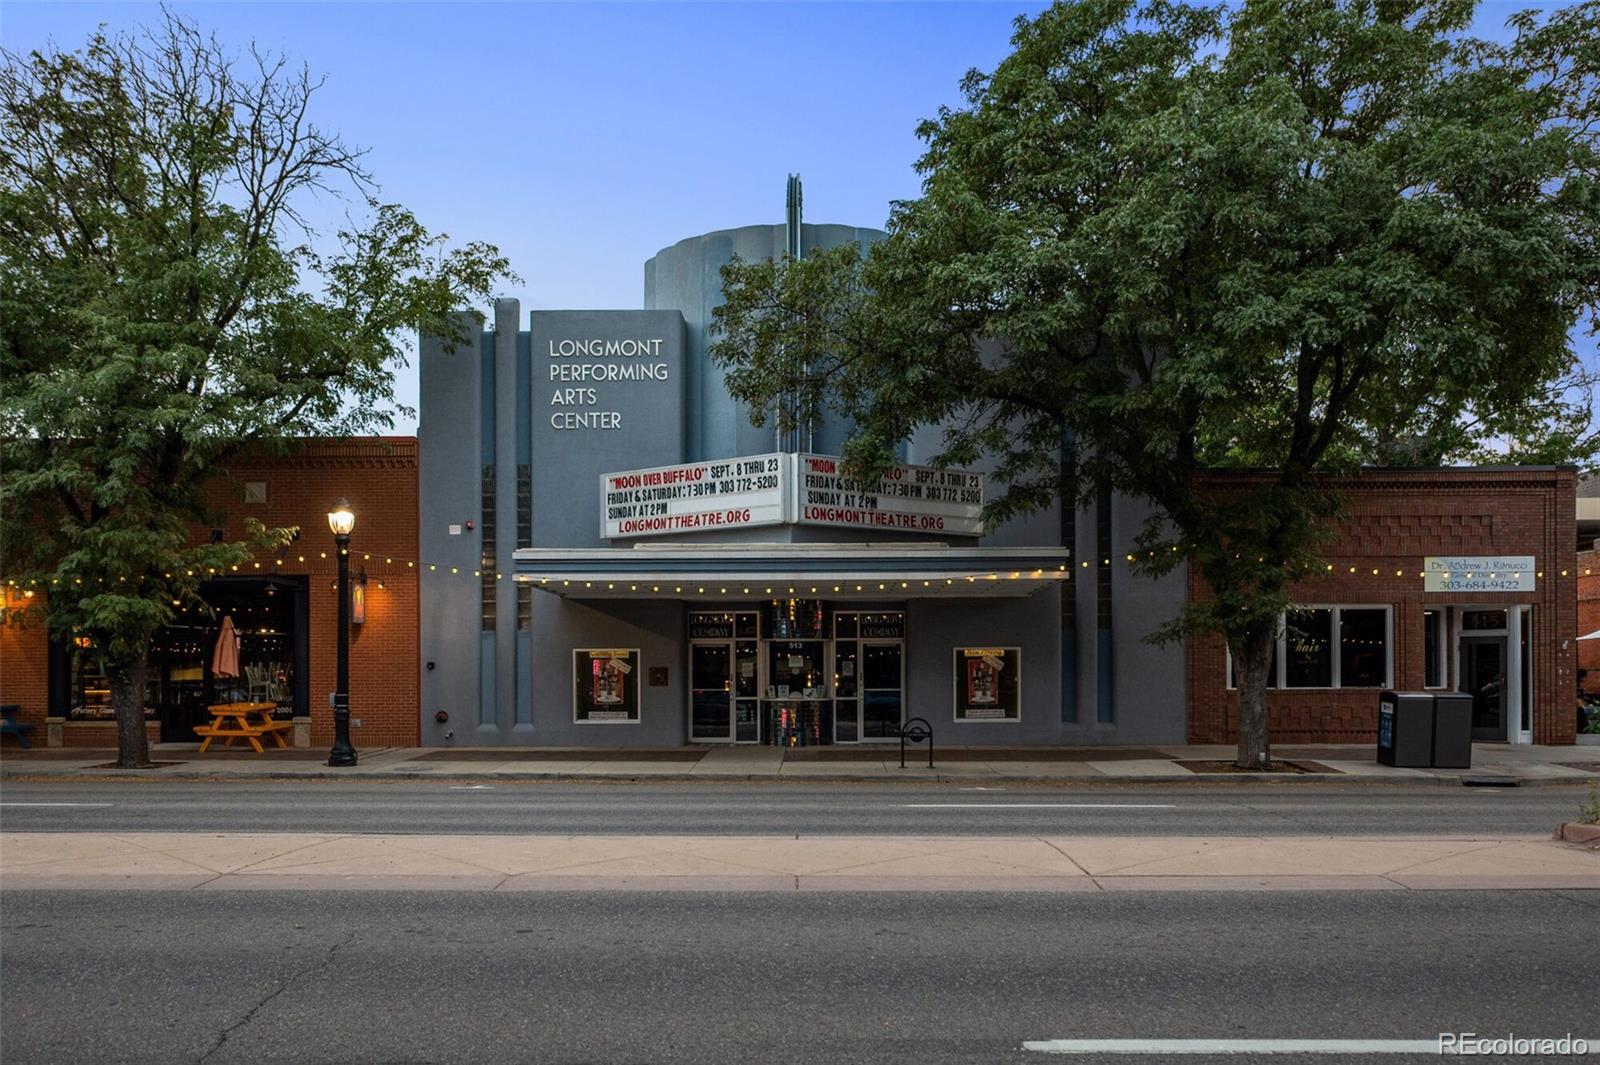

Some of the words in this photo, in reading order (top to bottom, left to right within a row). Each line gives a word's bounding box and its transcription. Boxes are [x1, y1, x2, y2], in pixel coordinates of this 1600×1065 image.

[549, 339, 663, 357] LONGMONT
[550, 363, 668, 381] PERFORMING
[551, 388, 597, 405] ARTS
[551, 412, 621, 429] CENTER
[643, 472, 661, 486] OVER
[711, 464, 734, 479] SEPT.
[737, 463, 742, 476] 8
[744, 460, 765, 475] THRU
[767, 458, 779, 472] 23
[915, 470, 938, 484] SEPT.
[940, 472, 945, 485] 8
[947, 473, 966, 487] THRU
[969, 476, 979, 487] 23
[607, 490, 633, 505] FRIDAY
[634, 490, 641, 502] &
[719, 480, 735, 493] 303
[736, 475, 778, 492] 772-5200
[805, 475, 835, 489] FRIDAY
[836, 478, 843, 490] &
[926, 486, 941, 499] 303
[808, 491, 841, 505] SUNDAY
[844, 494, 855, 507] AT
[608, 505, 637, 519] SUNDAY
[639, 504, 649, 516] AT
[1448, 559, 1481, 570] Andrew
[1439, 580, 1520, 590] 303-684-9422
